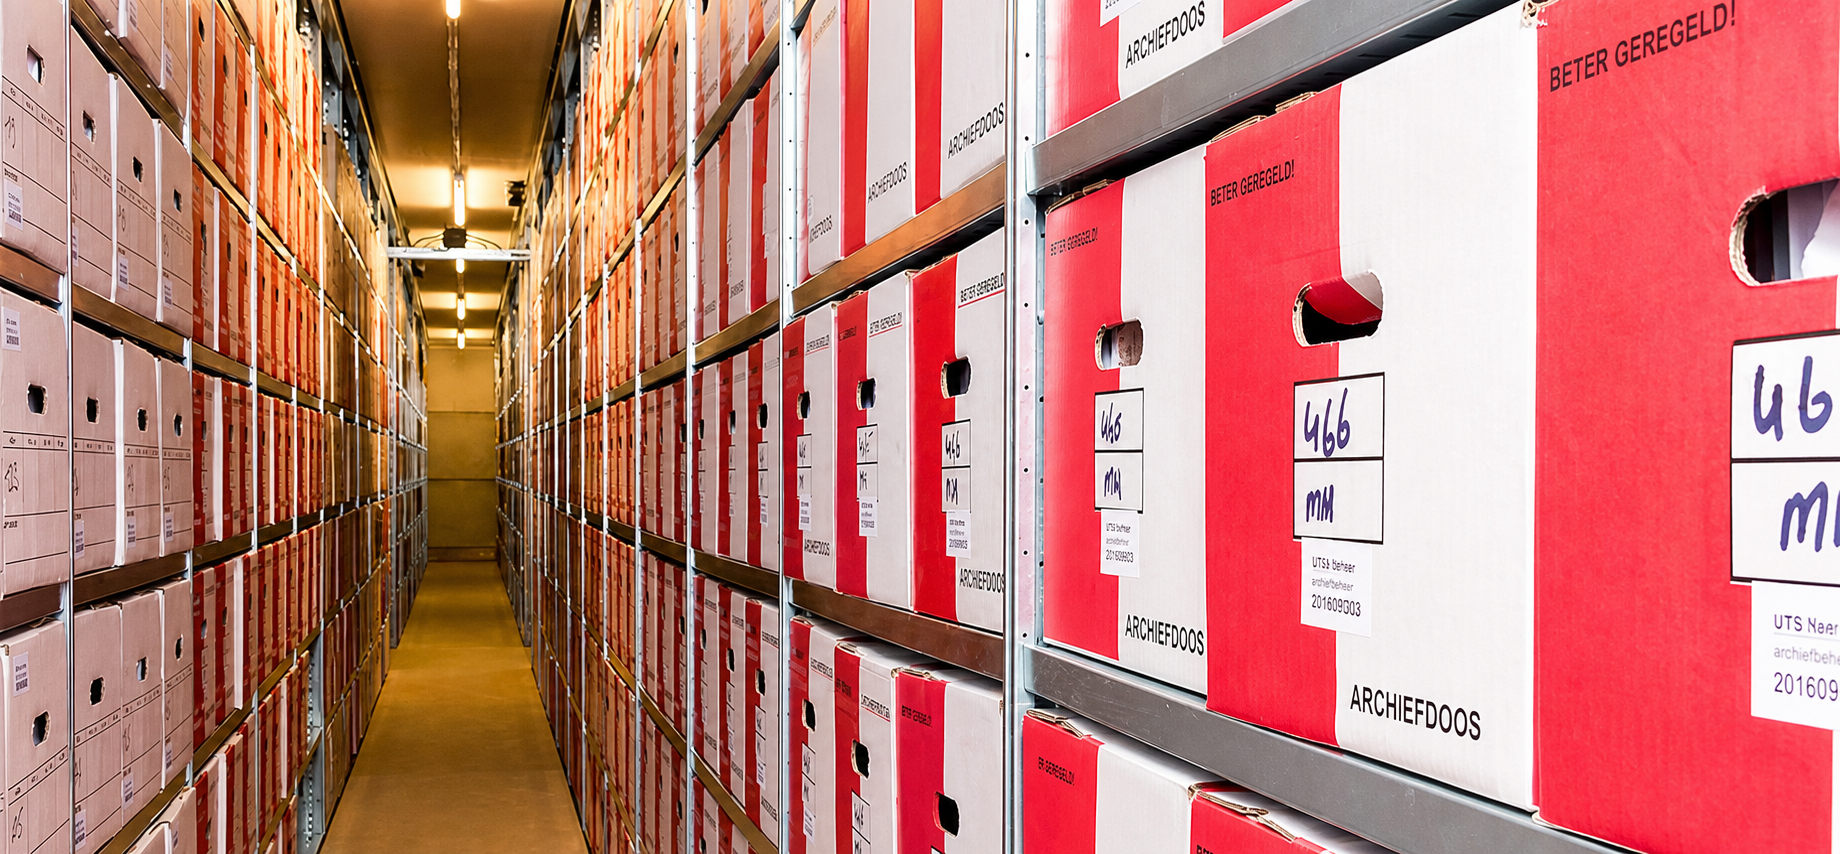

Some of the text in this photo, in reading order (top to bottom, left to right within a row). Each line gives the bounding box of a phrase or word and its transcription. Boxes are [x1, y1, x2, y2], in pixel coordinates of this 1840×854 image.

[1125, 1, 1206, 69] ARCHIEFDOOS
[1550, 0, 1736, 93] BETER GEREGELD!
[947, 101, 1004, 160] ARCHIEFDOOS
[1210, 158, 1295, 207] BETER GEREGELD!
[1124, 614, 1205, 656] ARCHIEFDOOS
[1774, 613, 1803, 632] UTS
[1350, 684, 1481, 741] ARCHIEFDOOS
